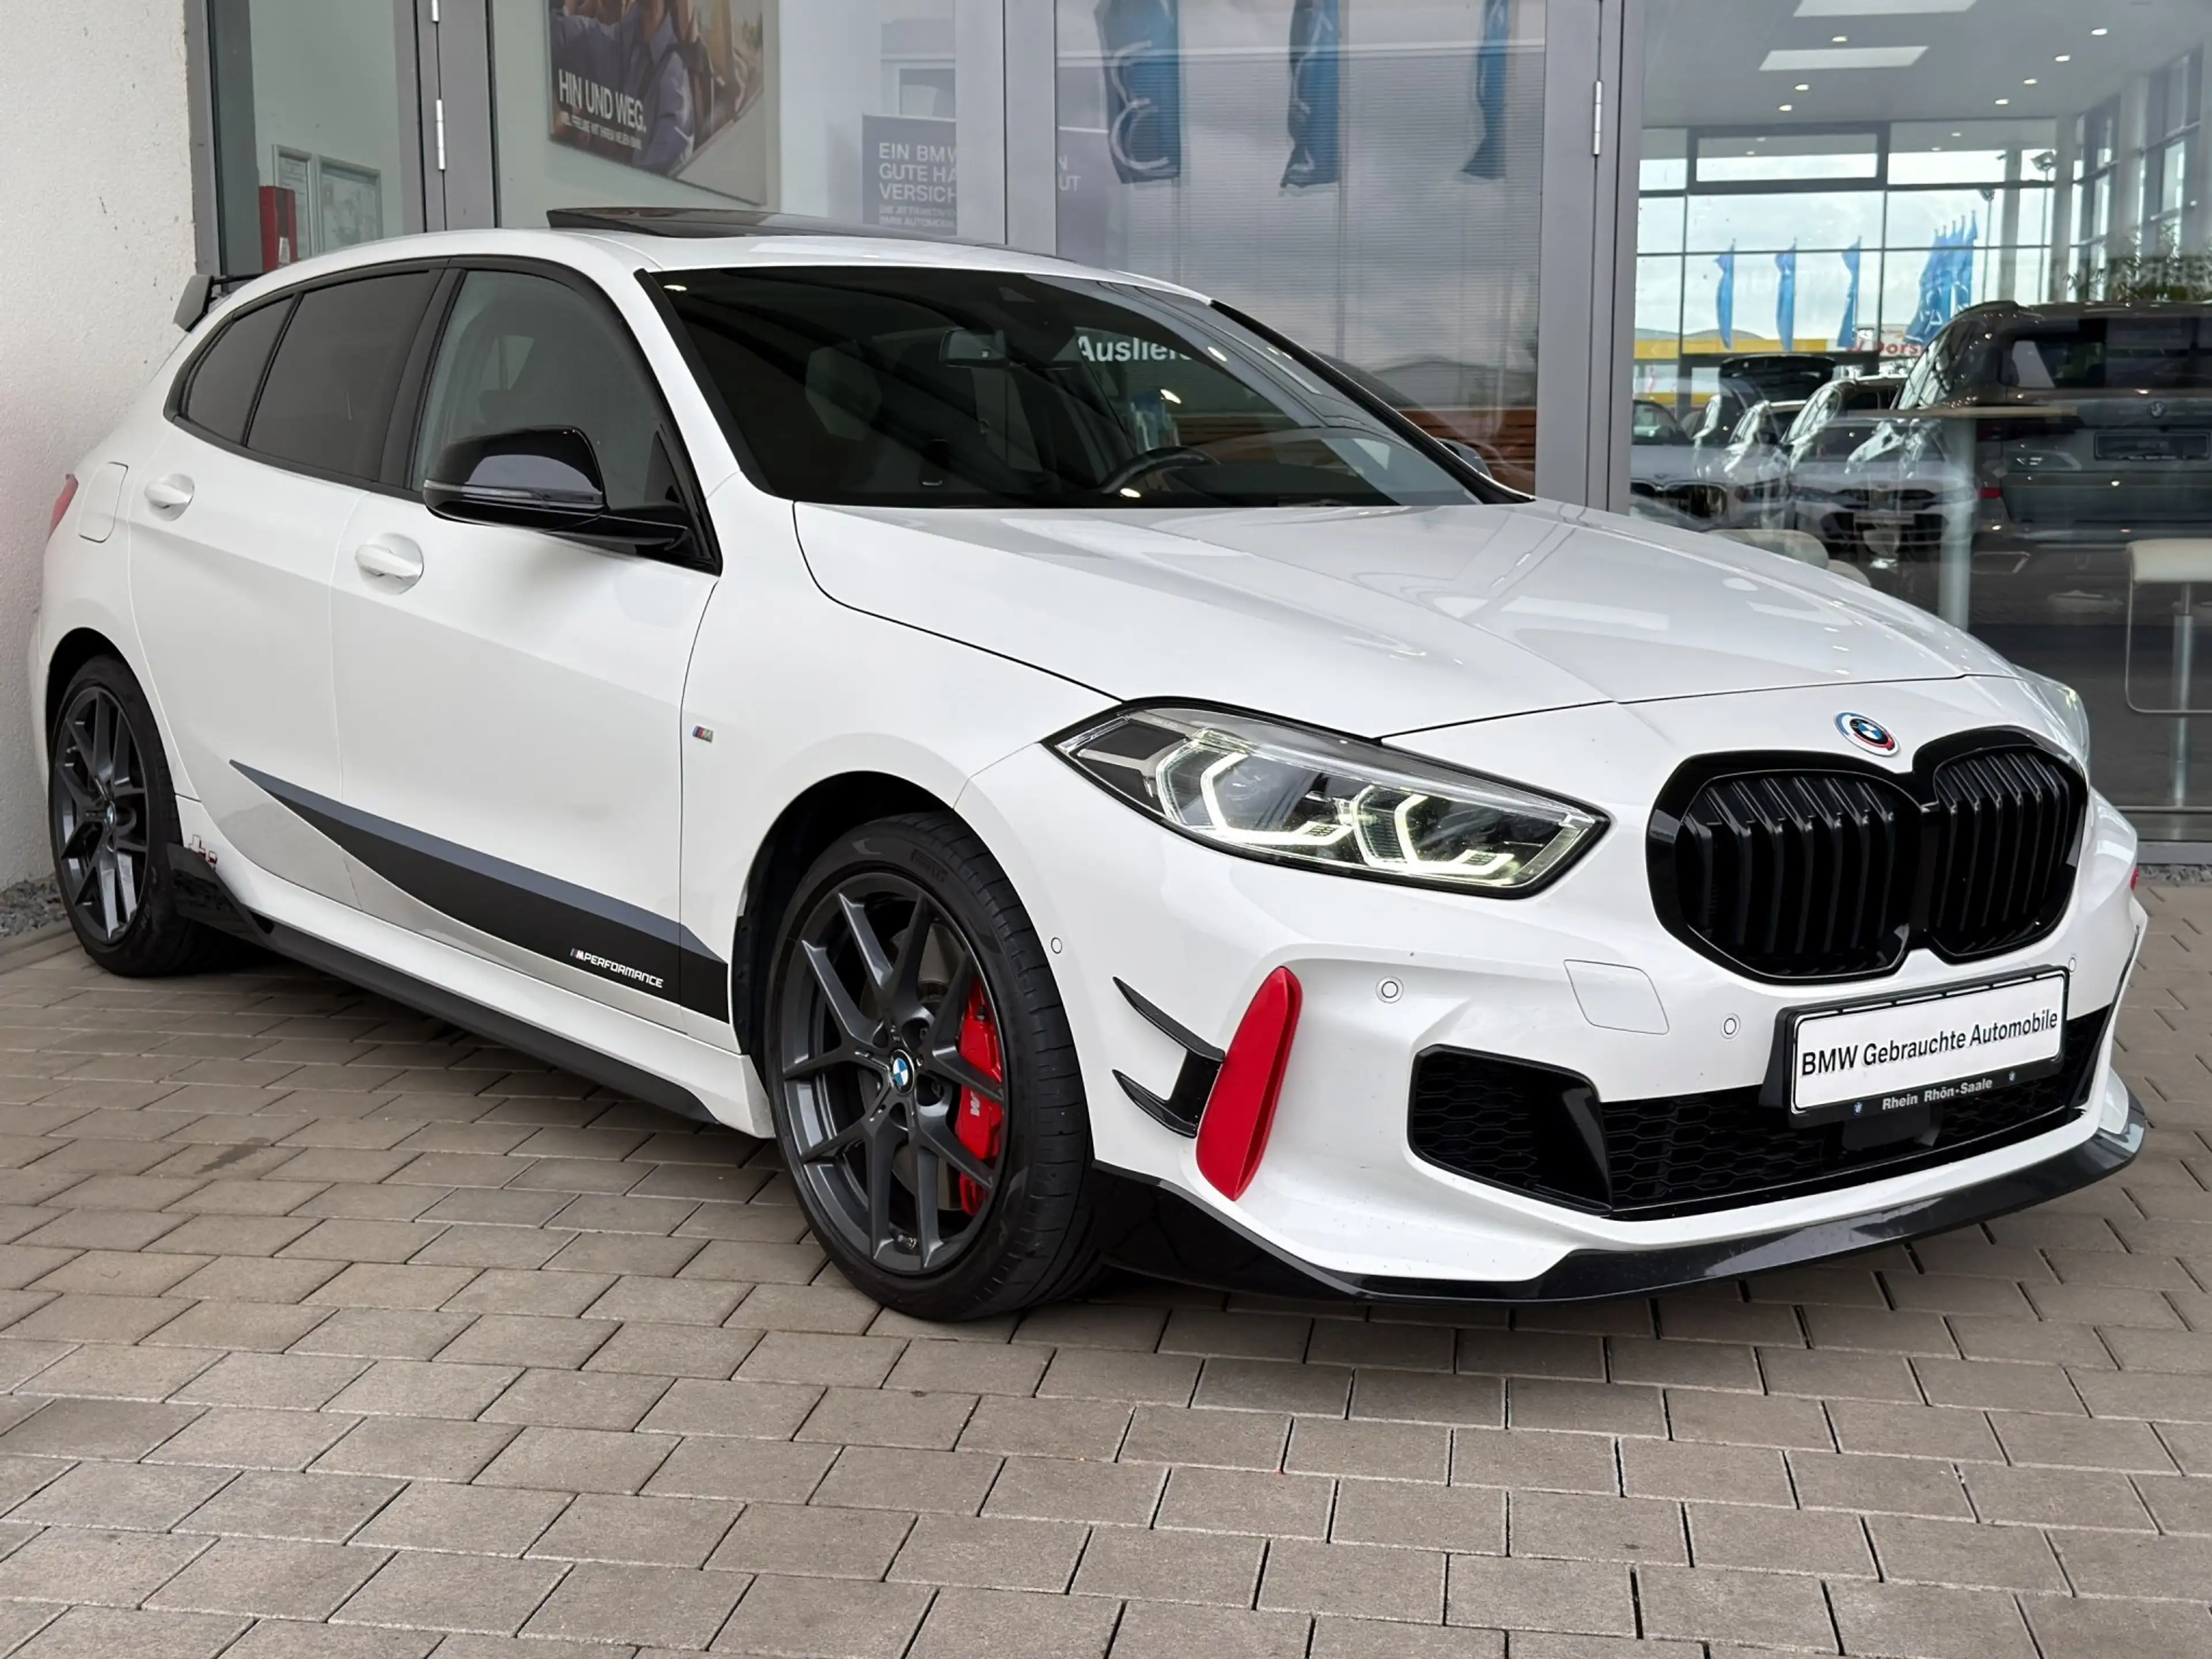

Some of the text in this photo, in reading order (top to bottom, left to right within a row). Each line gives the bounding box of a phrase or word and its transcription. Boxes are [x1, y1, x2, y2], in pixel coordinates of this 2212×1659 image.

[558, 68, 582, 110] HIN
[585, 78, 613, 120] UND
[615, 91, 647, 134] WEG.
[879, 142, 909, 160] EIN
[879, 163, 928, 183] GUTE
[1077, 335, 1192, 362] Auslie
[584, 952, 664, 988] PERFORMANCE
[1801, 1008, 2058, 1076] BMW Gebrauchte Automobile
[1881, 1093, 1919, 1111] Rhein
